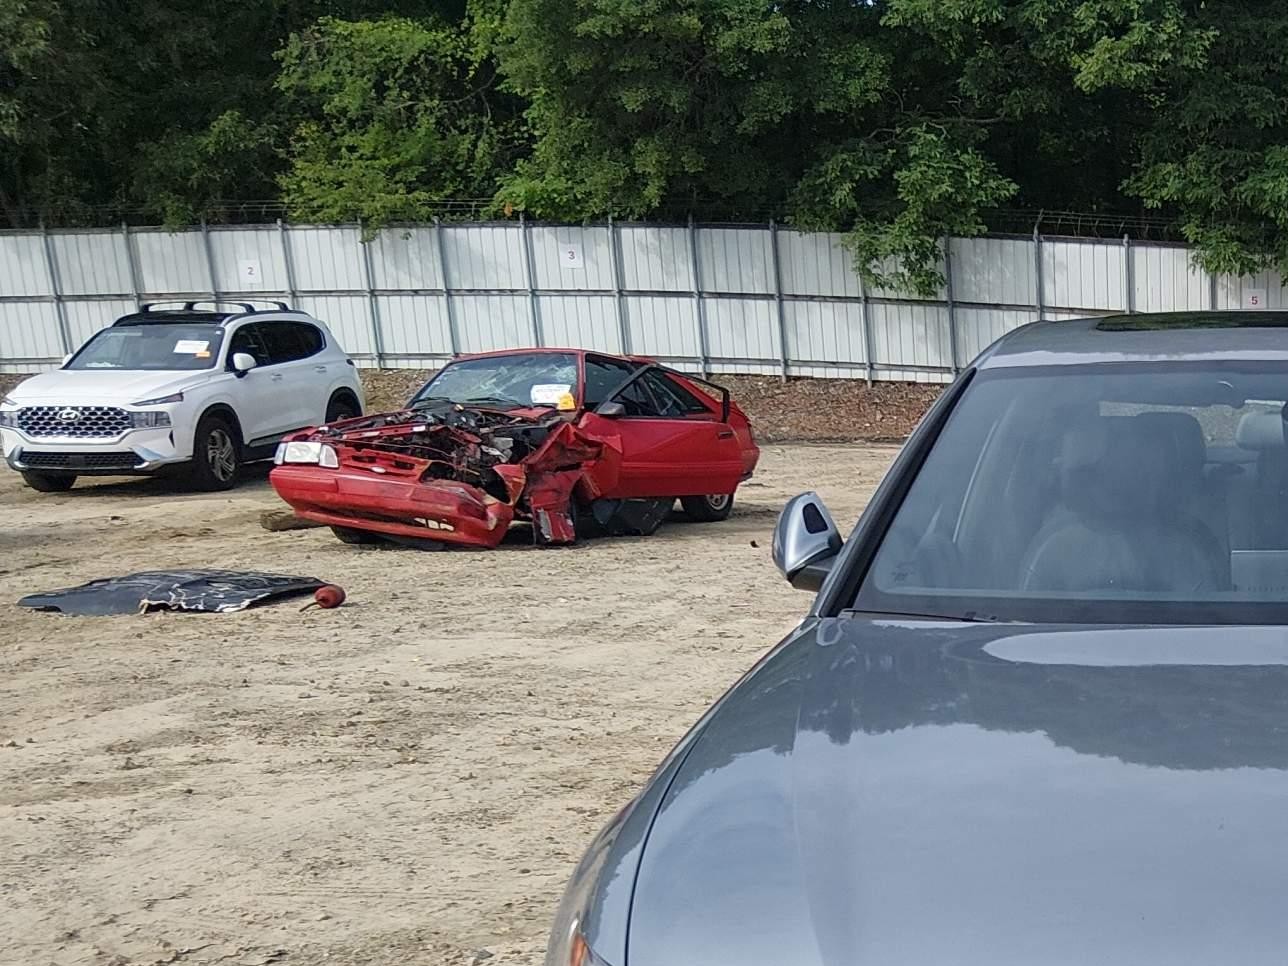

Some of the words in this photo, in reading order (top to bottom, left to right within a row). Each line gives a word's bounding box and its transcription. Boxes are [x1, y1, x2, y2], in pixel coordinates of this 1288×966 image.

[568, 250, 576, 260] 3
[247, 266, 255, 276] 2
[1251, 296, 1259, 305] 5
